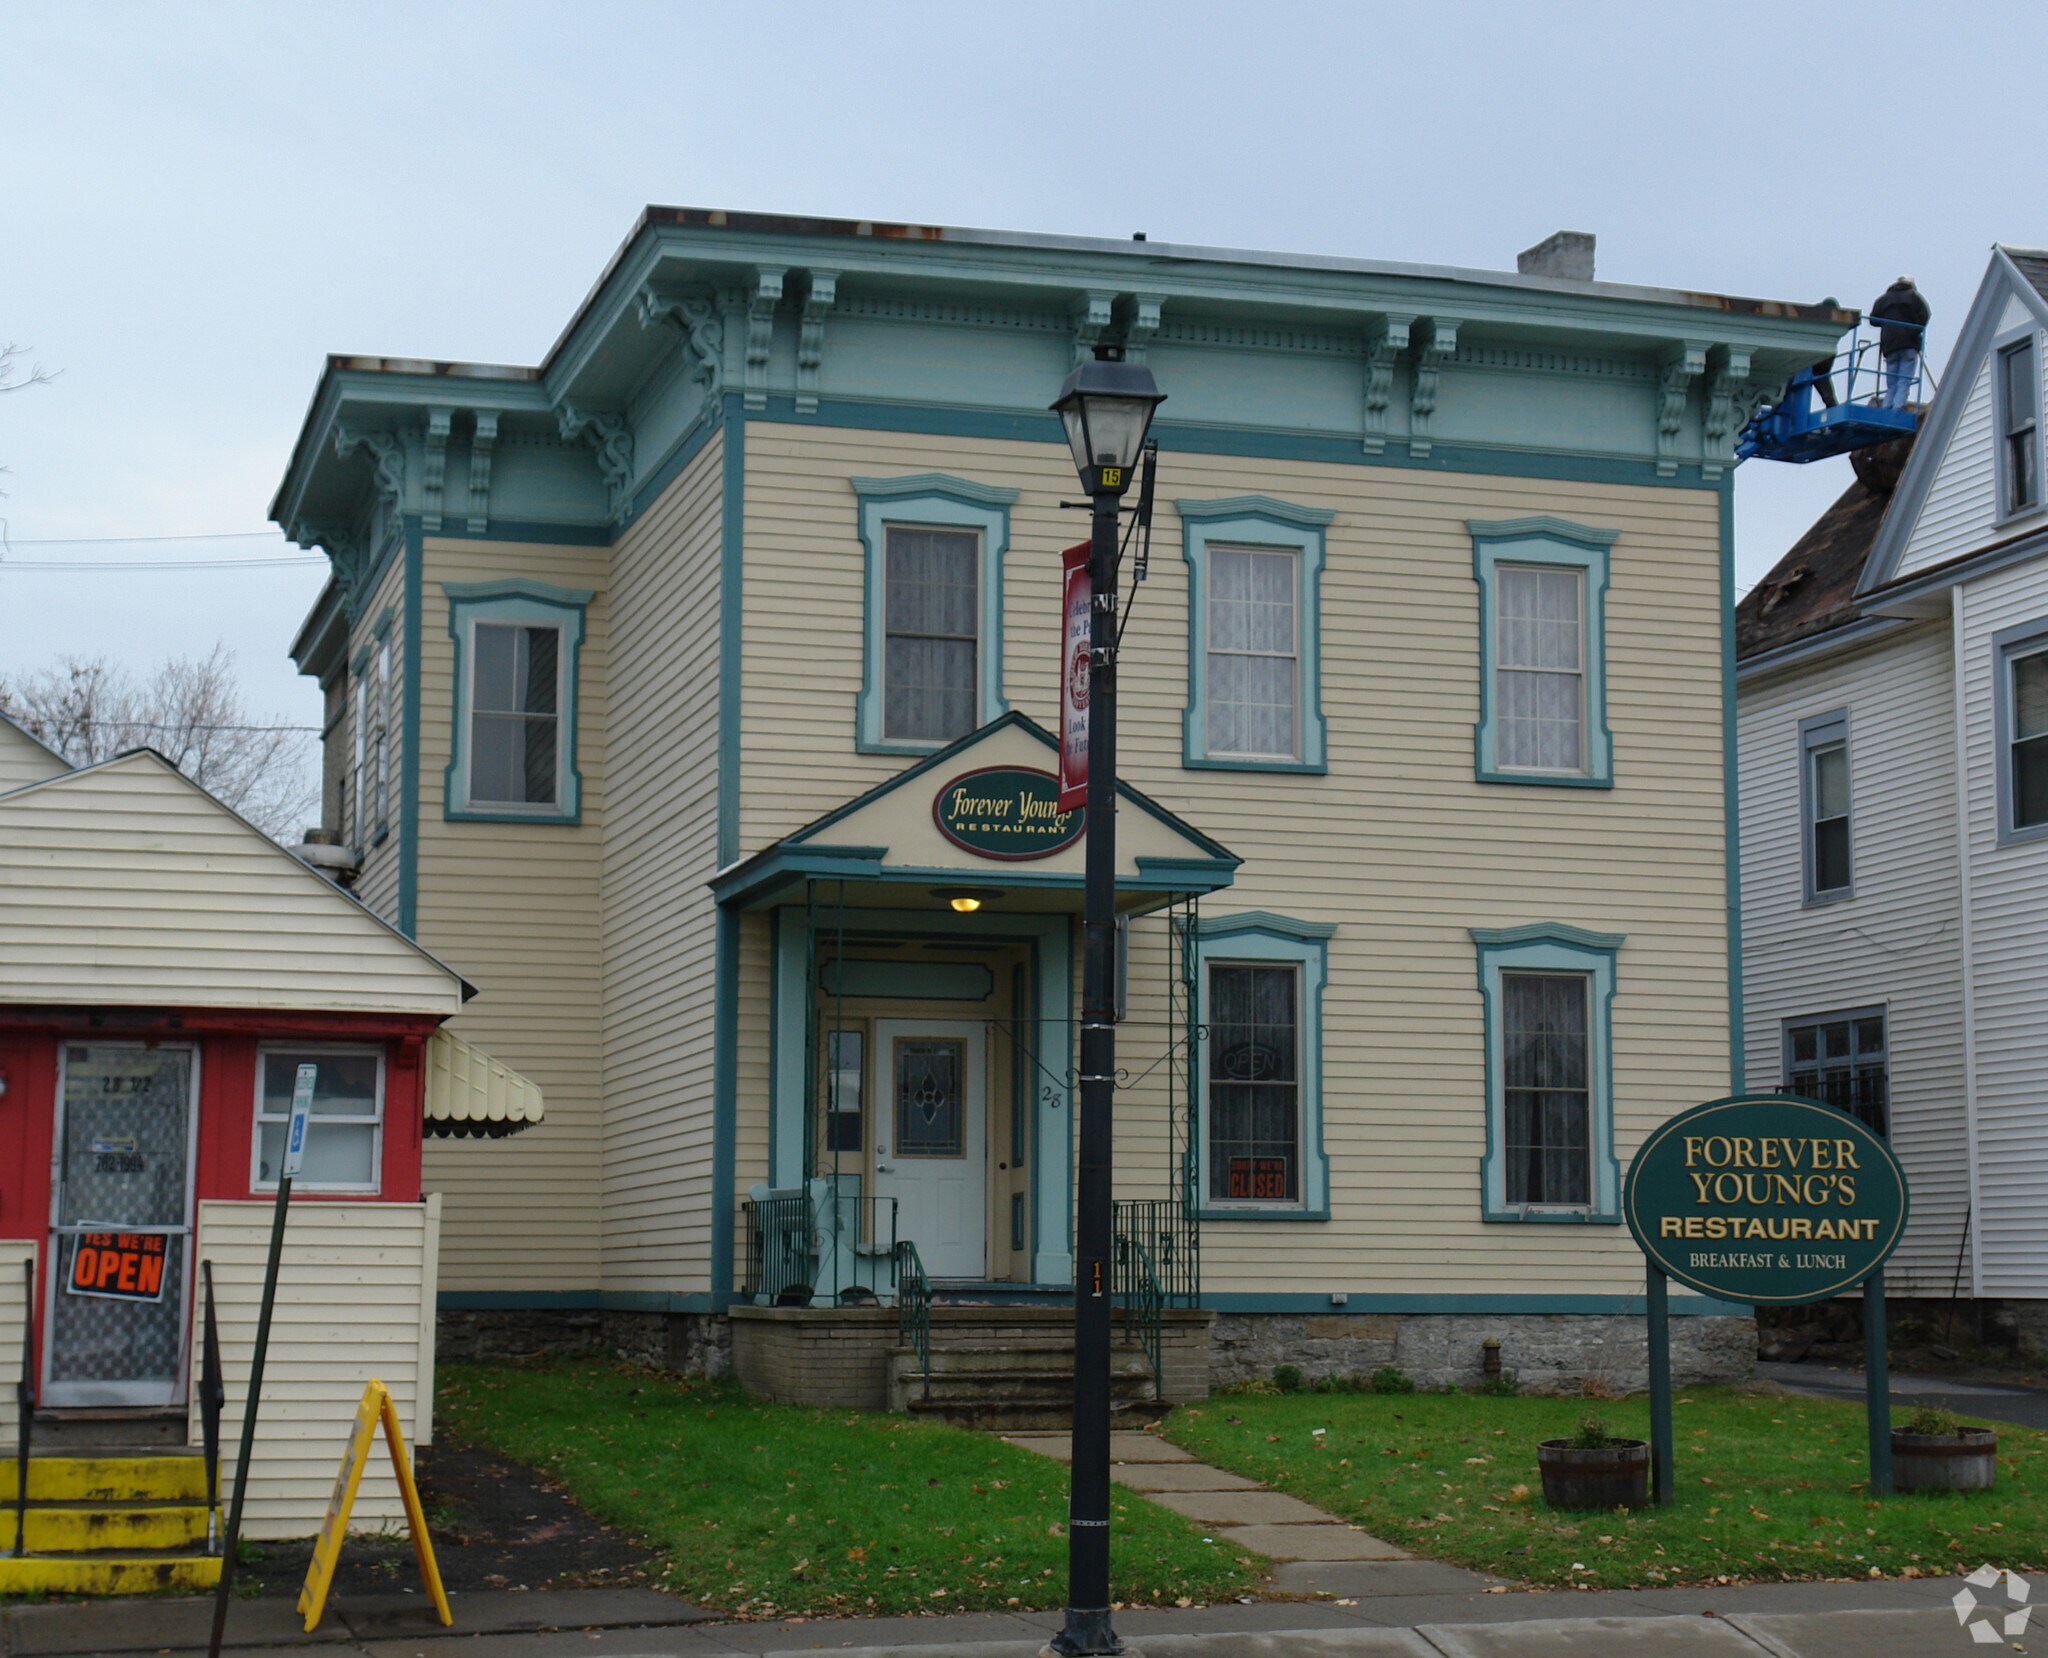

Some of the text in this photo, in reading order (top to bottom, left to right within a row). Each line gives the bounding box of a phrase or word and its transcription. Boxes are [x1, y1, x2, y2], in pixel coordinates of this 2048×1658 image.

[1104, 470, 1119, 483] 15
[1069, 600, 1091, 618] Celebr
[1068, 716, 1086, 734] Look
[948, 788, 1013, 821] Forever
[956, 822, 1068, 835] RESTAURANT
[1224, 1051, 1276, 1072] OPEN
[103, 1076, 122, 1093] 28
[1042, 1086, 1062, 1109] 28
[1682, 1135, 1861, 1170] FOREVER
[1231, 1173, 1284, 1197] CLOSED
[1690, 1172, 1856, 1206] YOUNG'S
[1660, 1216, 1880, 1240] RESTAURANT
[85, 1232, 163, 1252] YES WE'RE
[74, 1247, 163, 1294] OPEN
[1689, 1253, 1847, 1269] BREAKFAST & LUNCH
